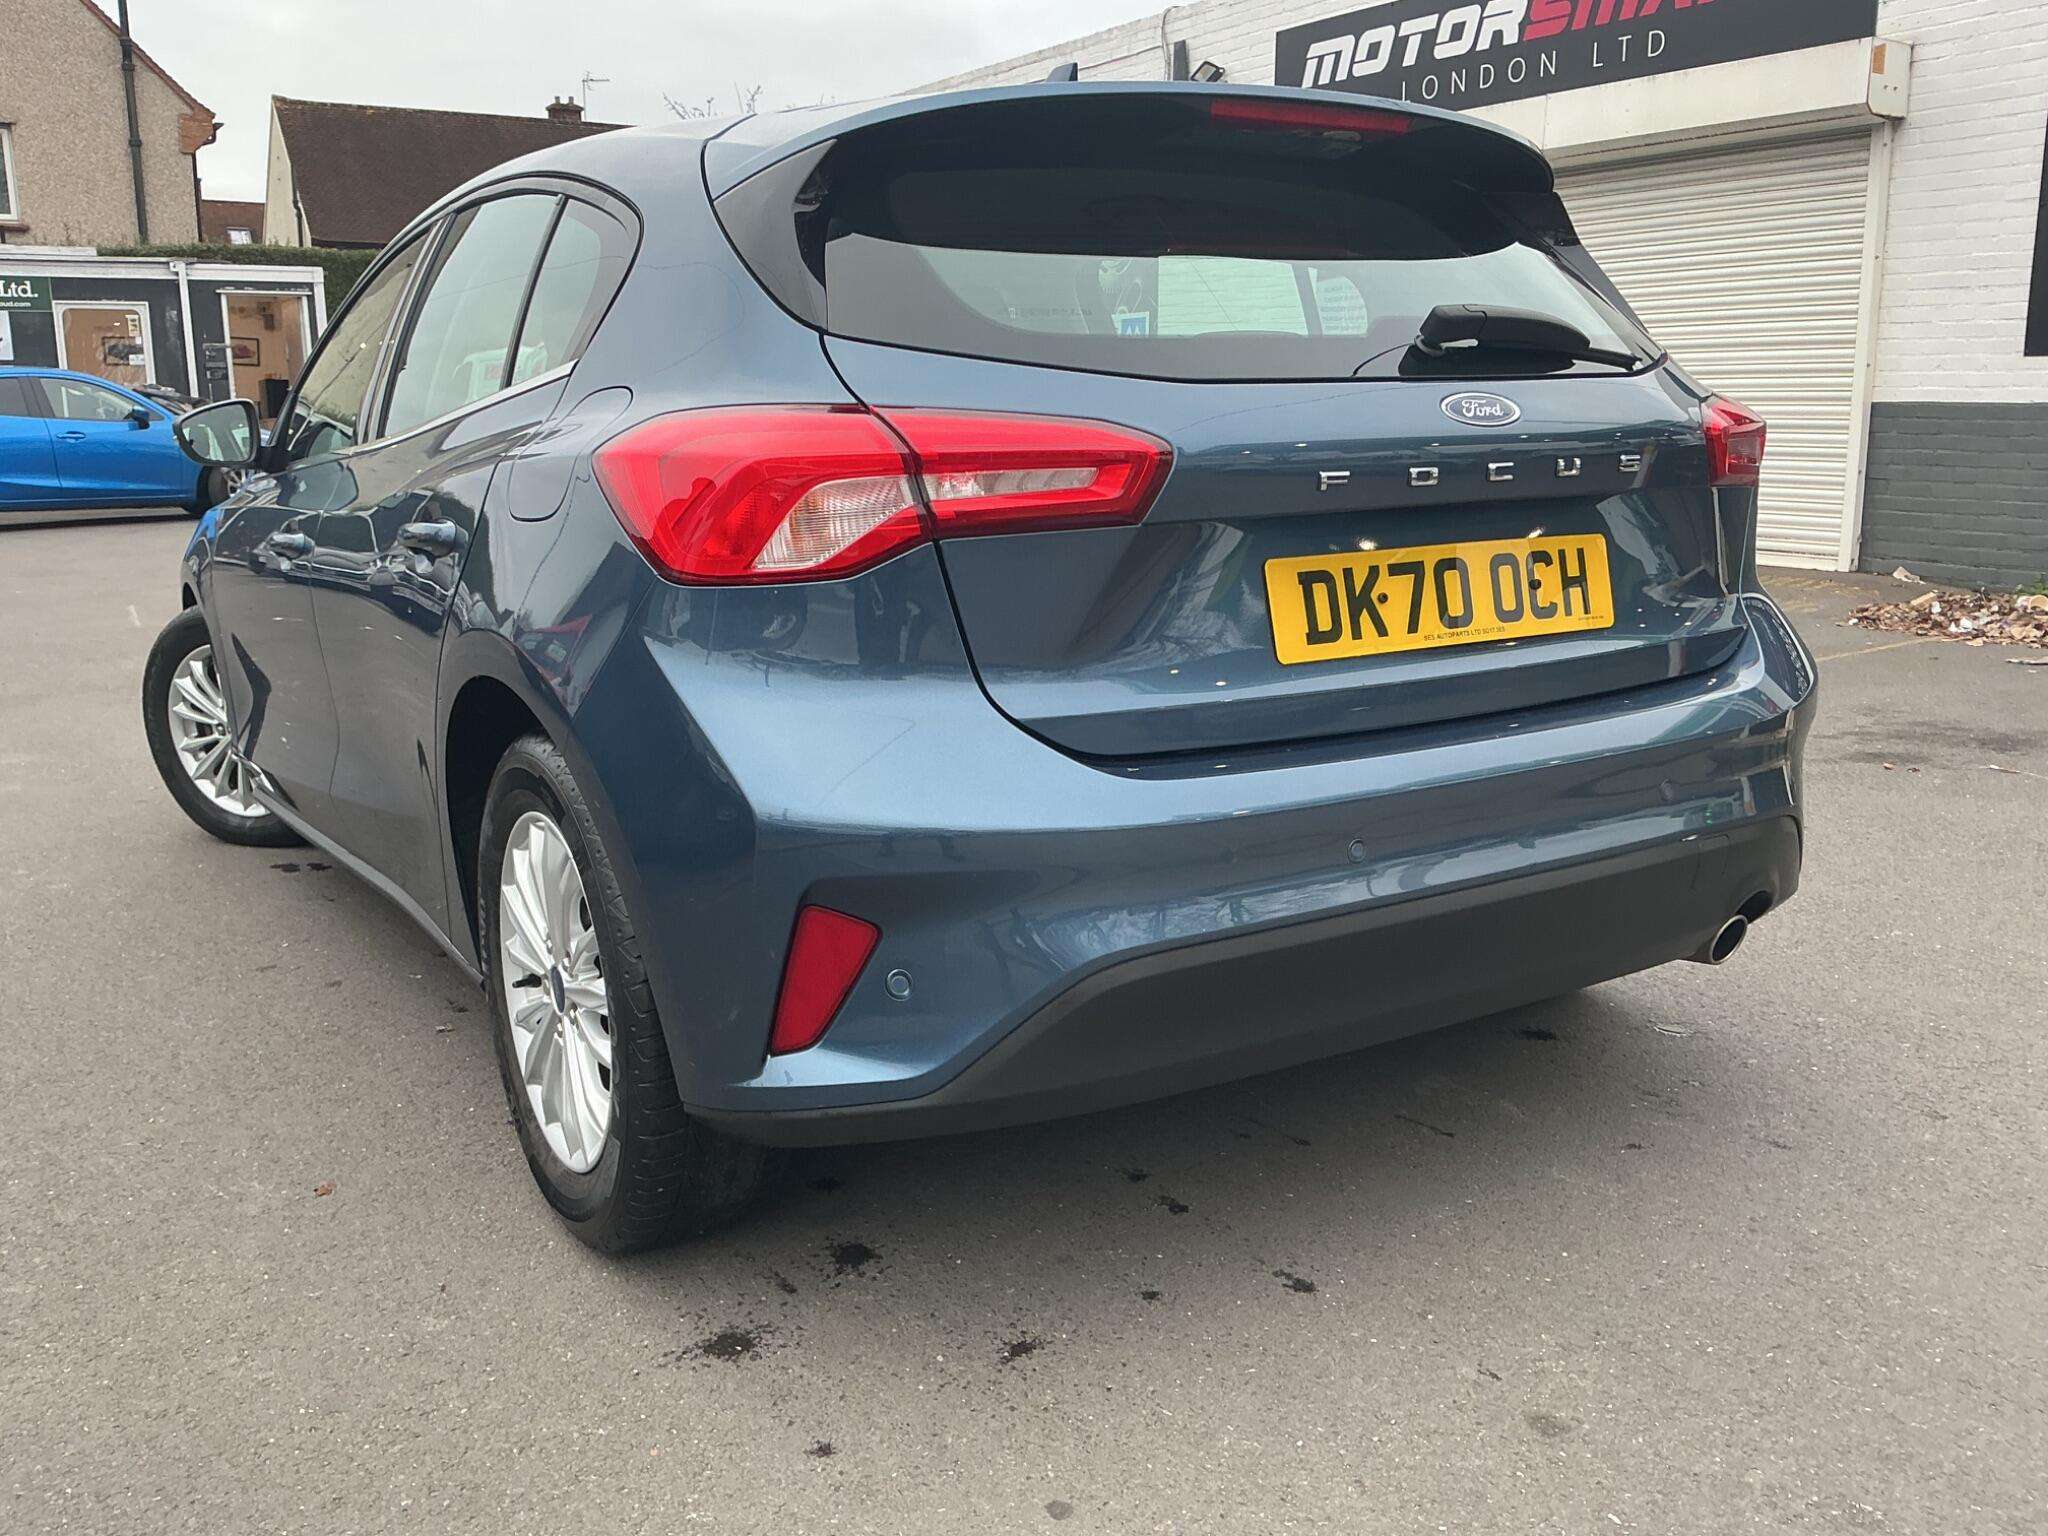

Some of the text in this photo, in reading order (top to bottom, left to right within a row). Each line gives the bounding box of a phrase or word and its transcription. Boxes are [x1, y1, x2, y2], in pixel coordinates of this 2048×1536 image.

[1402, 30, 1666, 102] LONDON LTD
[1462, 399, 1504, 417] Ford
[1317, 454, 1642, 492] FOCUS
[1296, 547, 1592, 646] DK70 OCH
